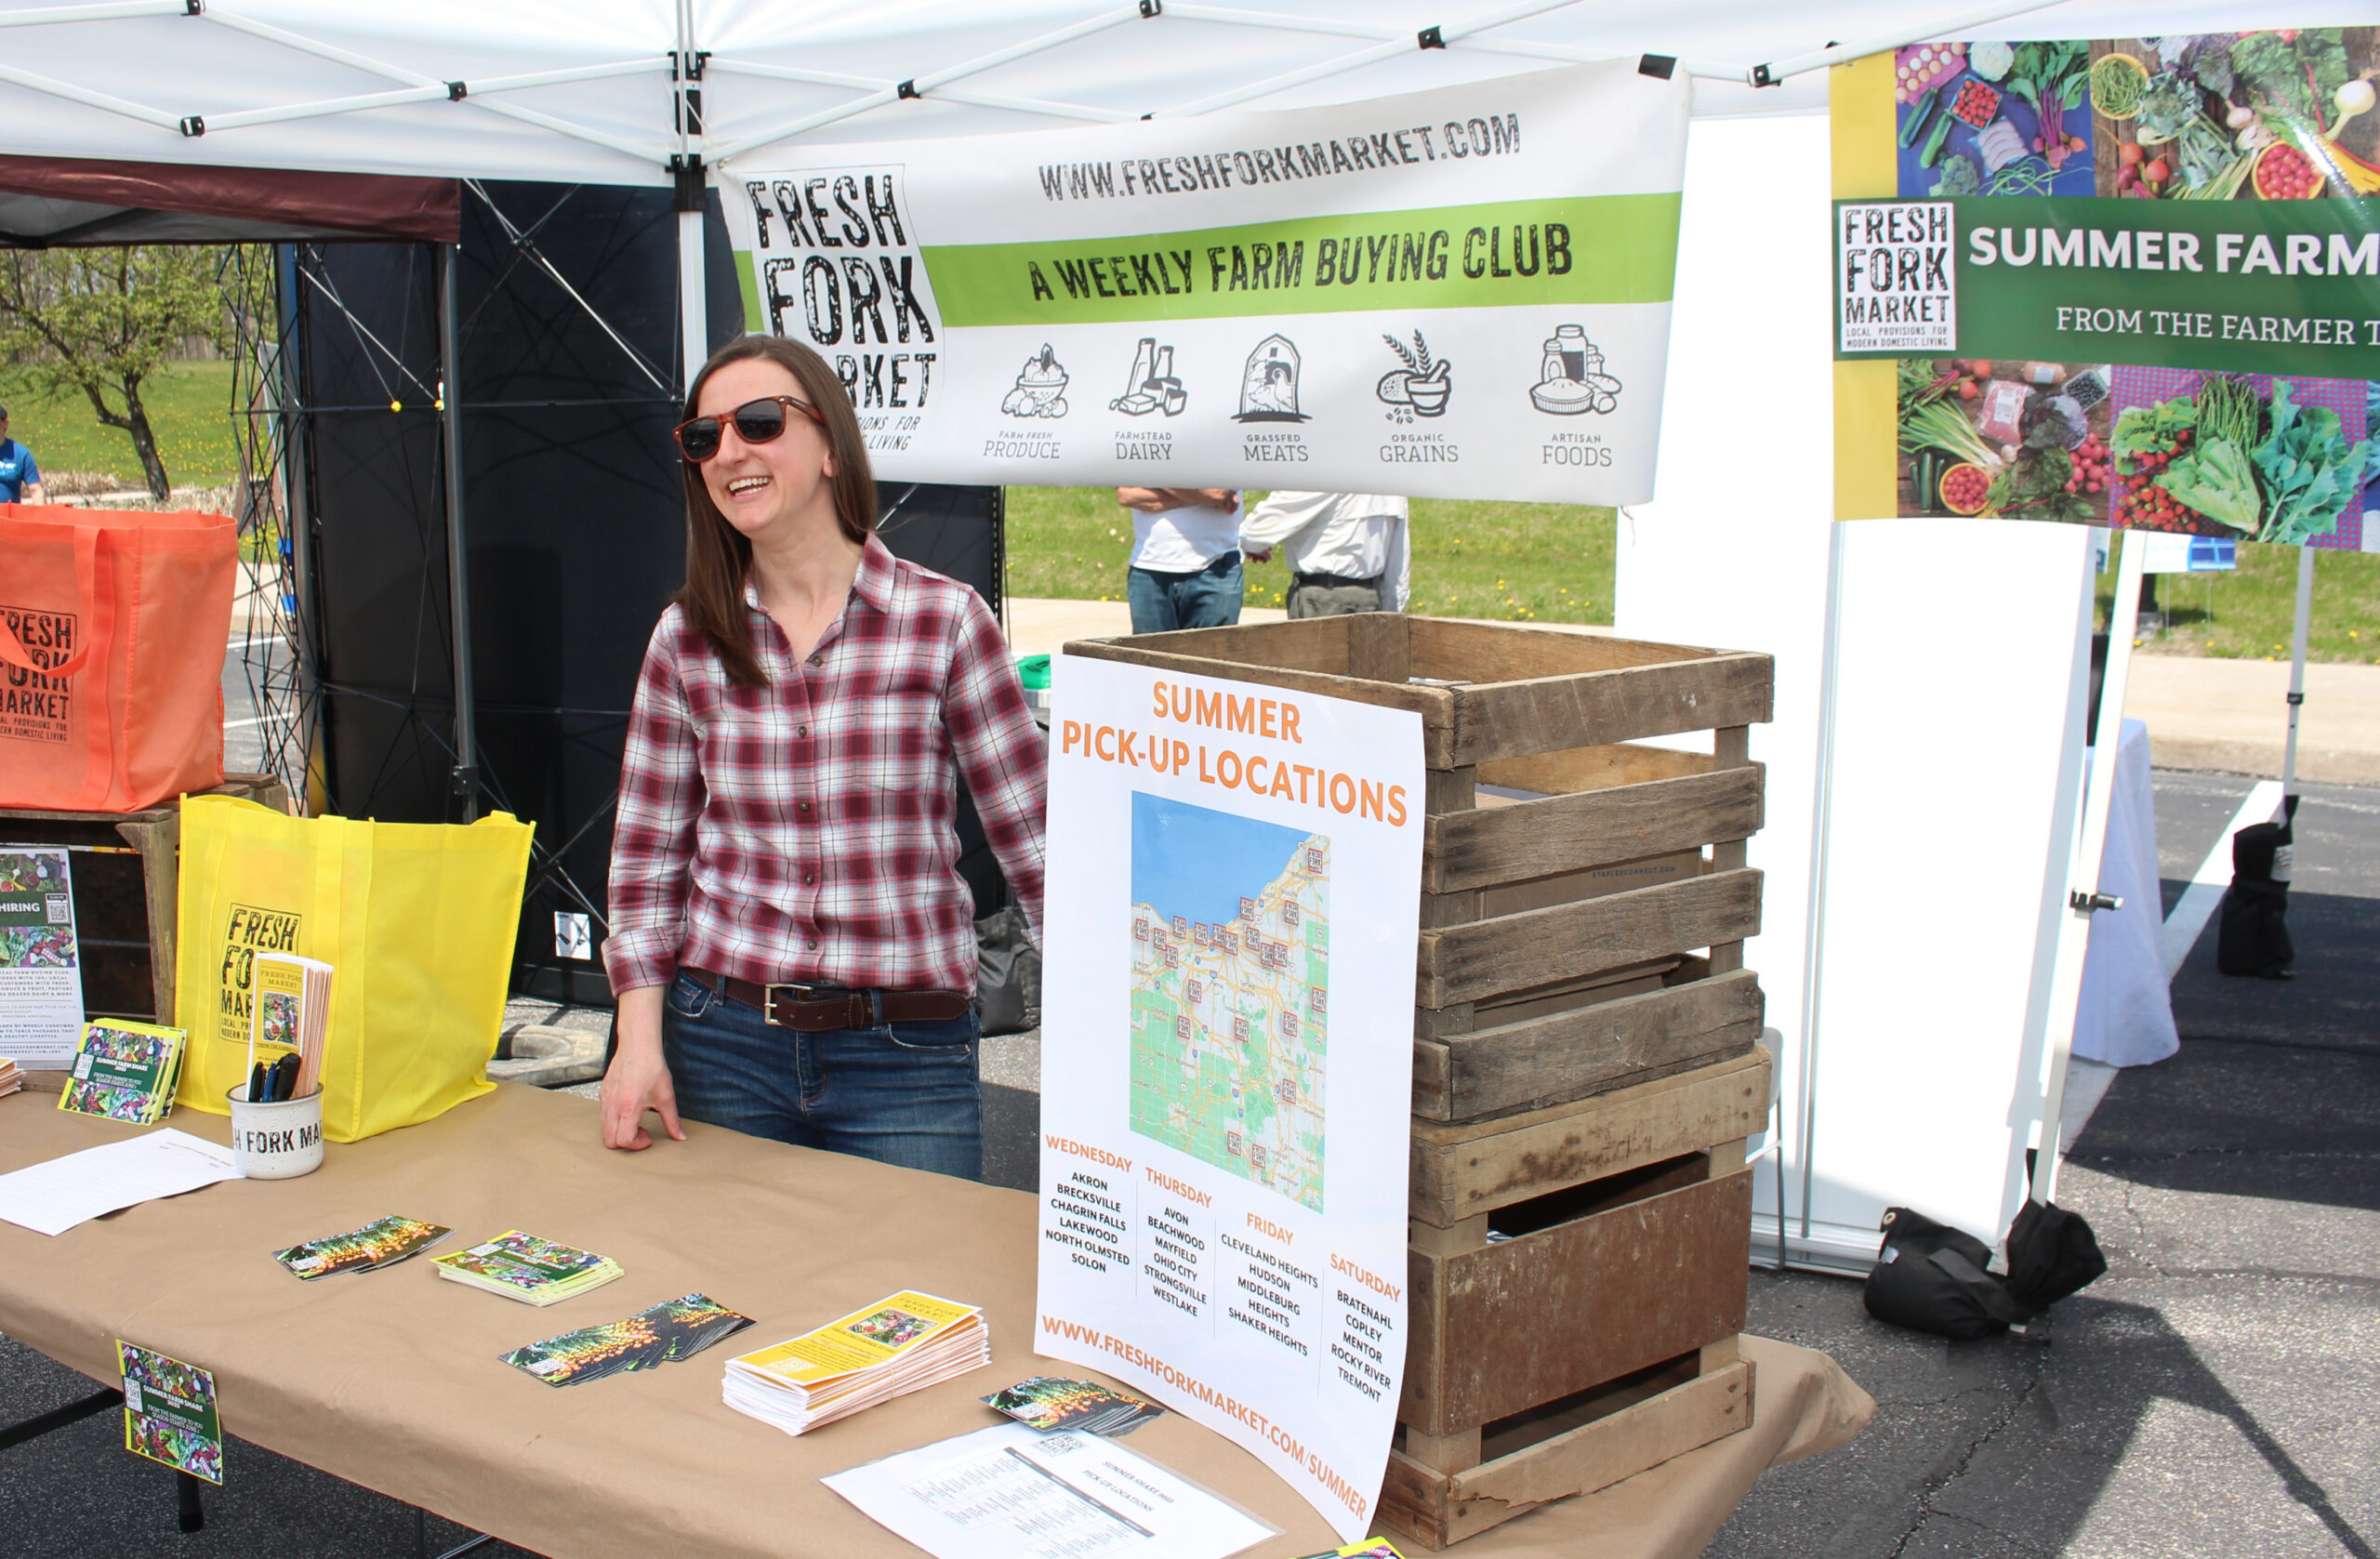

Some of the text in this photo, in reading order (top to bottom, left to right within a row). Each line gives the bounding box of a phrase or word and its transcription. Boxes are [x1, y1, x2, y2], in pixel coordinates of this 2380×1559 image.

[1038, 112, 1521, 202] WWW.FRESHFORKMARKET.COM
[747, 174, 906, 249] FRESH
[1845, 207, 1947, 244] FRESH
[1027, 223, 1573, 301] A WEEKLY FARM BUYING CLUB
[1968, 226, 2380, 276] SUMMER FARM
[1846, 247, 1949, 292] FORK
[764, 256, 935, 345] FORK
[1845, 296, 1950, 324] MARKET
[1846, 326, 1948, 337] LOCAL PROVISIONS FOR
[2056, 306, 2142, 334] FROM
[2150, 310, 2213, 337] THE
[2220, 314, 2356, 346] FARMER
[1846, 337, 1948, 348] MODERN DOMESTIC LIVING
[837, 352, 936, 408] RKET
[895, 416, 920, 430] FOR
[1026, 431, 1052, 440] FRESH
[1115, 431, 1172, 441] FARMSTEAD
[1552, 433, 1601, 443] ARTISAN
[869, 435, 911, 450] LIVING
[984, 441, 1061, 459] PRODUCE
[1116, 443, 1172, 460] DAIRY
[1243, 445, 1309, 462] MEATS
[1247, 434, 1301, 443] GRASSFED
[1380, 445, 1459, 462] GRAINS
[1392, 434, 1444, 443] ORGANIC
[1542, 445, 1612, 467] FOODS
[0, 611, 71, 649] RESH
[0, 649, 69, 693] ORK
[14, 718, 50, 730] PROVISIONS
[57, 722, 67, 732] FOR
[1152, 680, 1302, 744] SUMMER
[14, 728, 44, 739] DOMESTIC
[47, 732, 67, 742] LIVING
[1062, 720, 1408, 827] PICK-UP LOCATIONS
[0, 903, 40, 912] HIRING
[228, 908, 298, 951] FRESH
[222, 945, 255, 989] FO
[221, 989, 253, 1019] MAR
[221, 1018, 235, 1027] LOCAL
[221, 1028, 240, 1039] MODERN
[246, 1130, 295, 1154] FORK
[1046, 1134, 1132, 1172] WEDNESDAY
[1072, 1172, 1107, 1191] AKRON
[1145, 1167, 1212, 1209] THURSDAY
[1057, 1183, 1121, 1212] BRECKSVILLE
[1051, 1198, 1126, 1231] CHAGRIN FALLS
[1164, 1208, 1189, 1226] AVON
[1247, 1212, 1293, 1246] FRIDAY
[1060, 1217, 1117, 1244] LAKEWOOD
[1148, 1216, 1205, 1250] BEACHWOOD
[1046, 1229, 1130, 1265] NORTH OLMSTED
[1156, 1236, 1197, 1264] MAYFIELD
[1222, 1234, 1318, 1288] CLEVELAND HEIGHTS
[1072, 1253, 1106, 1273] SOLON
[1154, 1252, 1197, 1282] OHIO CITY
[1250, 1263, 1290, 1292] HUDSON
[1330, 1253, 1401, 1302] SATURDAY
[1144, 1264, 1207, 1304] STRONGSVILLE
[1237, 1276, 1301, 1315] MIDDLEBURG
[1153, 1285, 1197, 1316] WESTLAKE
[1249, 1299, 1289, 1328] HEIGHTS
[1338, 1289, 1393, 1329] BRATENAHL
[1228, 1307, 1307, 1356] SHAKER HEIGHTS
[1346, 1314, 1382, 1342] COPLEY
[1343, 1331, 1382, 1364] MENTOR
[1331, 1343, 1391, 1390] ROCKY RIVER
[1338, 1366, 1382, 1403] TREMONT
[1042, 1314, 1367, 1522] WWW.FRESHFORKMARKET.COM/SUMMER
